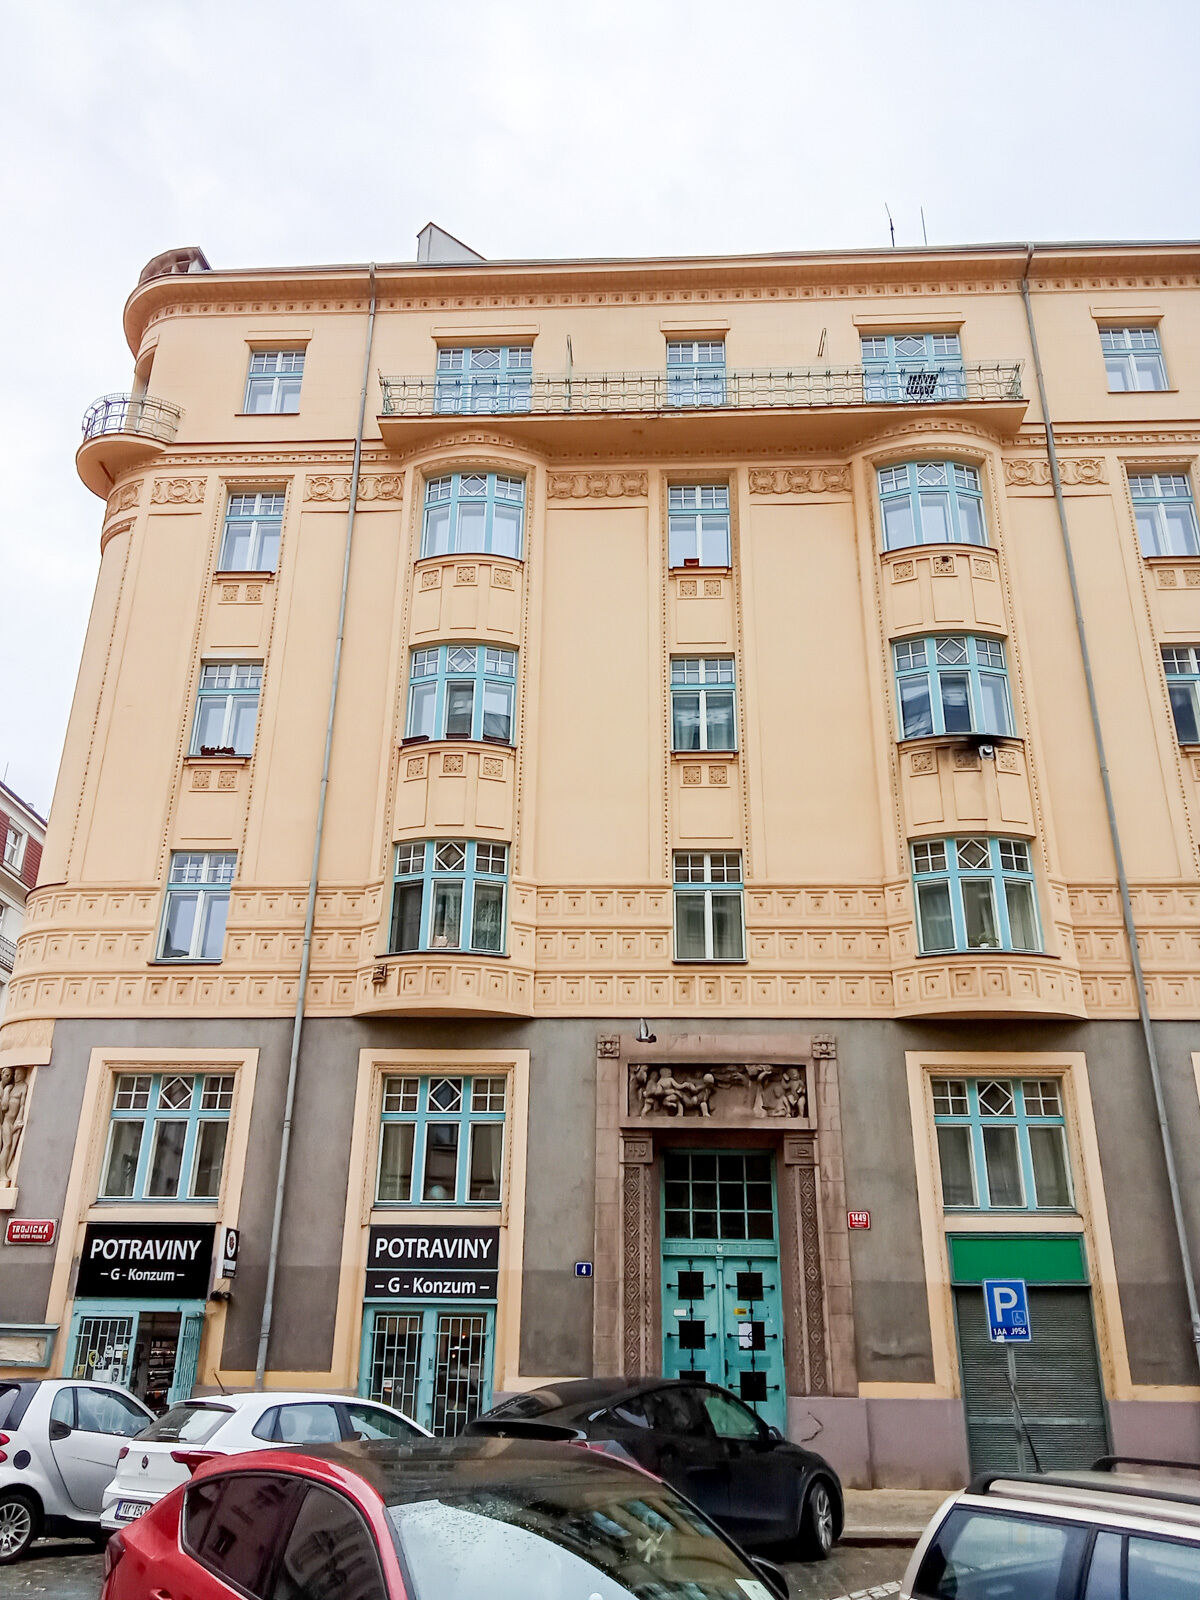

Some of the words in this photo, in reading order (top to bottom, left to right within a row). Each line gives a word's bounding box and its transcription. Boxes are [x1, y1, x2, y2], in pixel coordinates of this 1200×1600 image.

[851, 1213, 867, 1222] 1449
[12, 1224, 49, 1234] TROJICKÁ
[90, 1239, 202, 1260] POTRAVINY
[375, 1238, 493, 1259] POTRAVINY
[110, 1268, 120, 1280] G
[128, 1268, 175, 1281] Konzum
[581, 1265, 587, 1275] 4
[387, 1277, 400, 1293] G
[413, 1277, 476, 1294] Konzum
[993, 1287, 1018, 1322] P
[993, 1328, 1008, 1336] 1AA
[1010, 1327, 1027, 1335] J956
